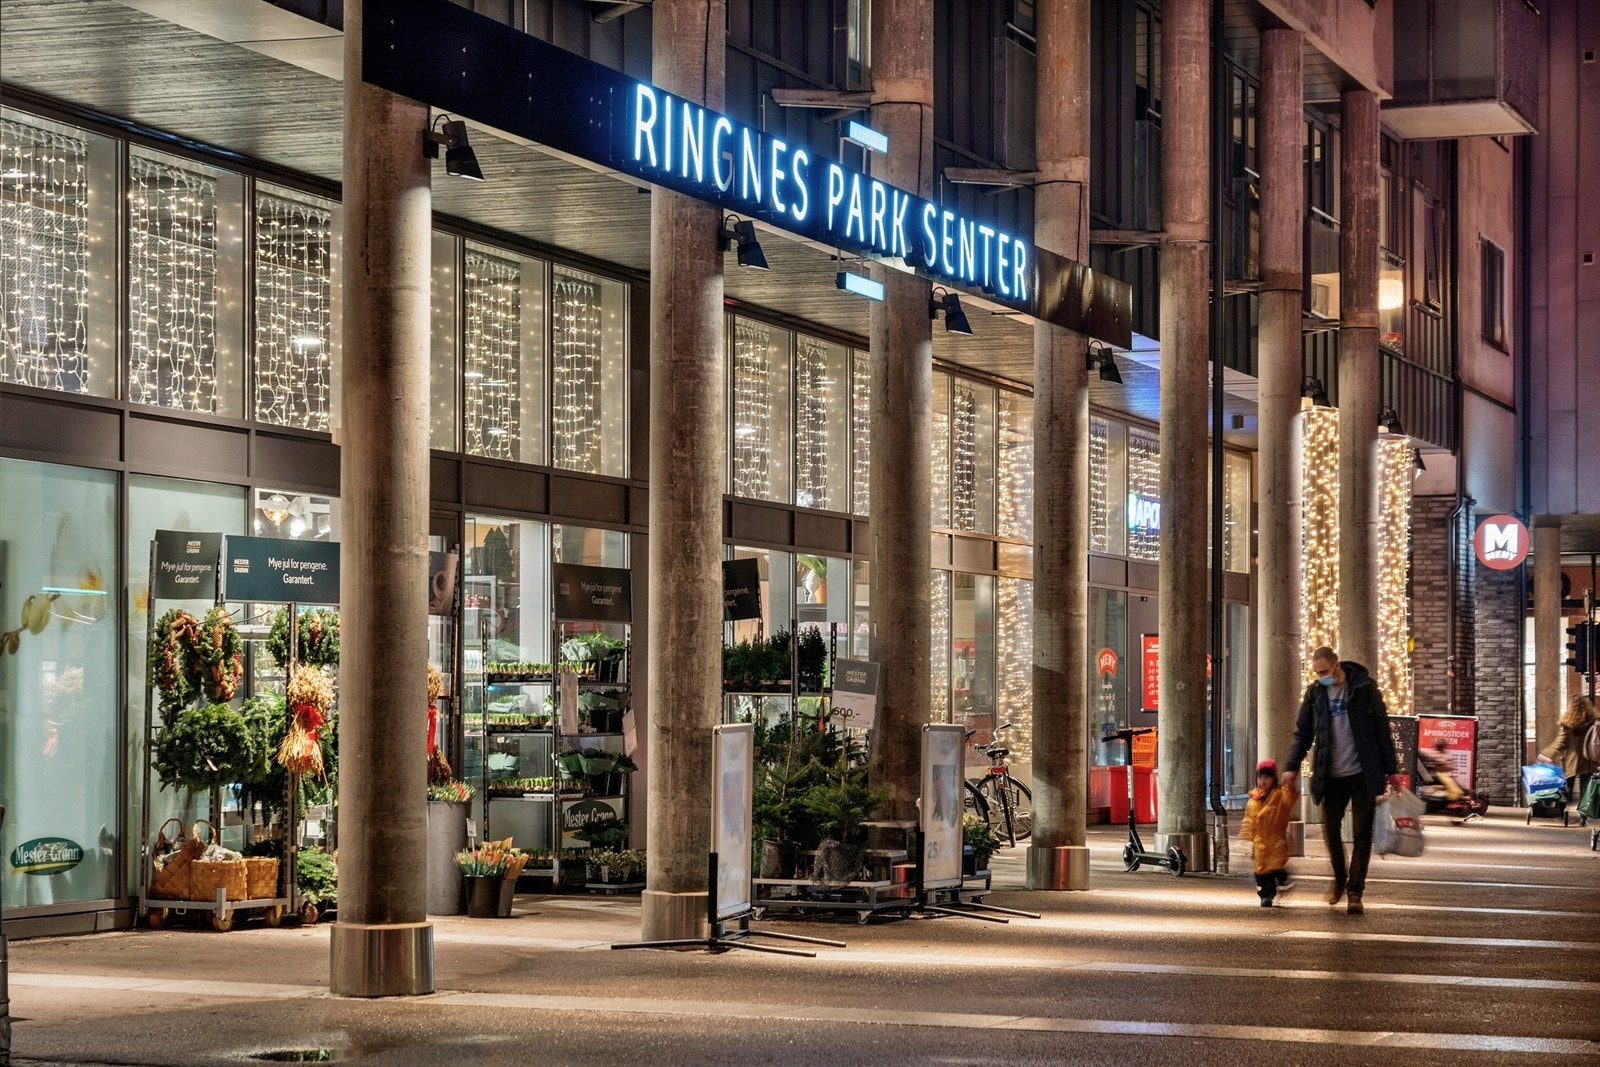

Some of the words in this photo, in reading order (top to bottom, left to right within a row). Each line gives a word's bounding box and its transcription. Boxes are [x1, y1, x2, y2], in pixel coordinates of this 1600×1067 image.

[634, 83, 809, 222] RINGNES
[828, 163, 909, 258] PARK
[923, 203, 1027, 301] SENTER
[160, 561, 176, 572] Mye
[175, 562, 184, 573] jul
[183, 562, 193, 571] for
[191, 563, 212, 573] pengene.
[268, 557, 282, 570] Mye
[282, 558, 291, 570] jul
[290, 558, 300, 569] for
[299, 561, 328, 573] pengene.
[282, 573, 315, 585] Garantert.
[1099, 653, 1116, 669] MENY
[832, 706, 860, 719] 500,-
[1423, 728, 1470, 738] ÅPNINGSTIDER
[563, 809, 590, 828] Mester
[15, 845, 47, 865] Mester
